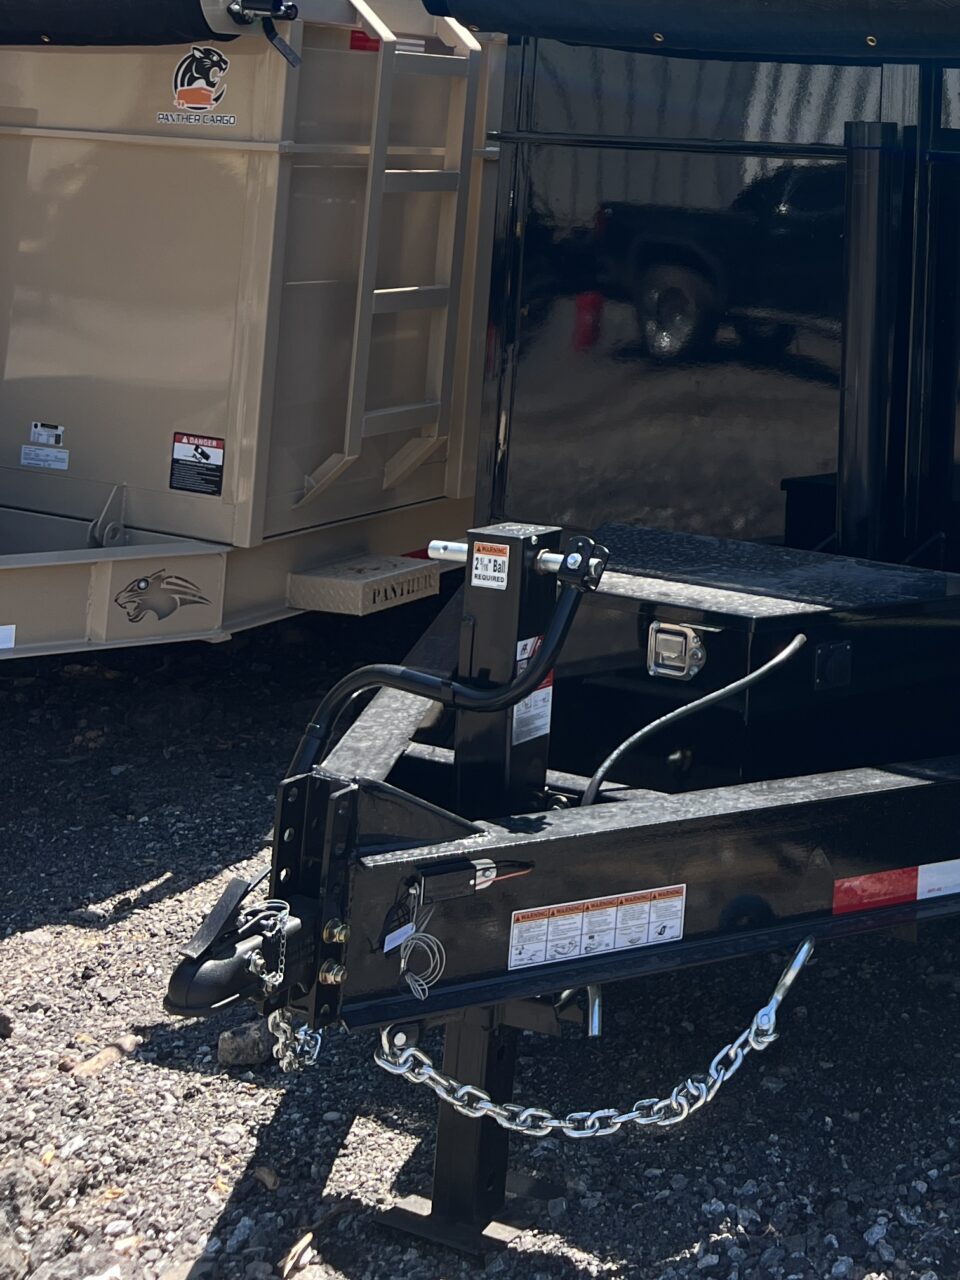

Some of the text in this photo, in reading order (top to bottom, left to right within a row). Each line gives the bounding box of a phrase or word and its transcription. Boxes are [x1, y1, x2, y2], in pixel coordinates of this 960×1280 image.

[157, 112, 236, 125] PANTHER CARGO
[189, 437, 217, 446] DANGER
[475, 557, 479, 570] 2
[493, 559, 506, 573] Ball
[474, 573, 505, 583] REQUIRED
[372, 574, 433, 605] PANTHER
